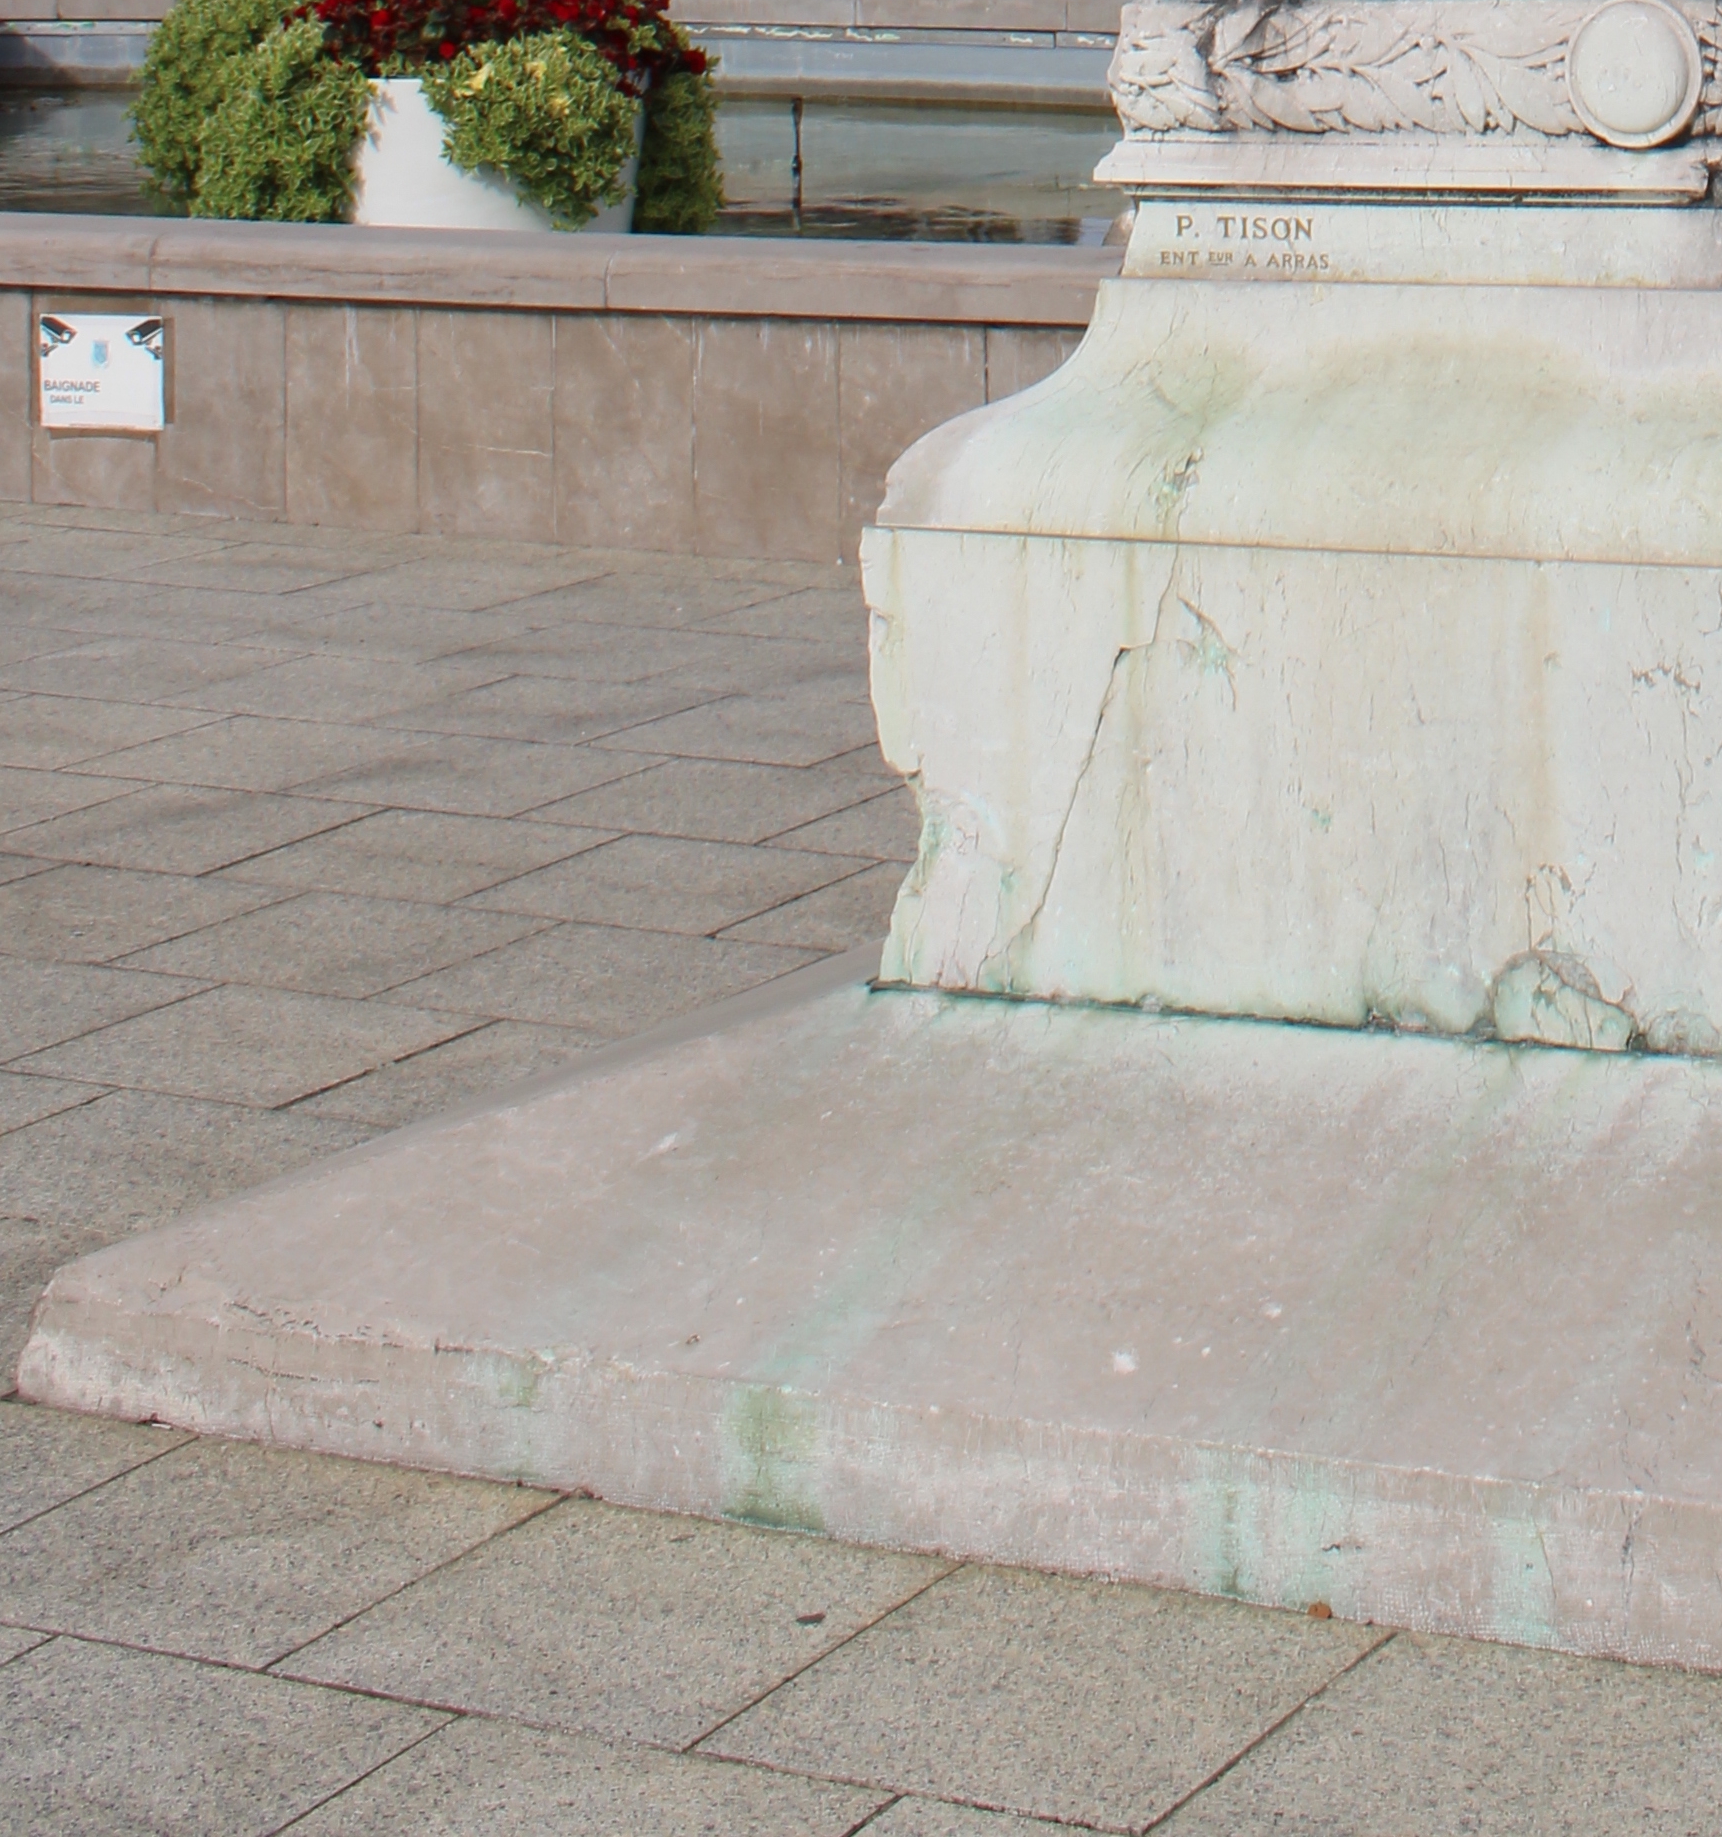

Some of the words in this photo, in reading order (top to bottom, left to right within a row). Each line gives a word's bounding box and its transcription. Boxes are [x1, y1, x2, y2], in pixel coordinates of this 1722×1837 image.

[1175, 213, 1200, 238] P.
[1216, 215, 1314, 242] TISON
[1243, 253, 1258, 268] A
[1265, 252, 1330, 270] ARRAS
[43, 379, 101, 393] BAIGNADE
[50, 394, 72, 404] DANS
[74, 395, 84, 404] LE
